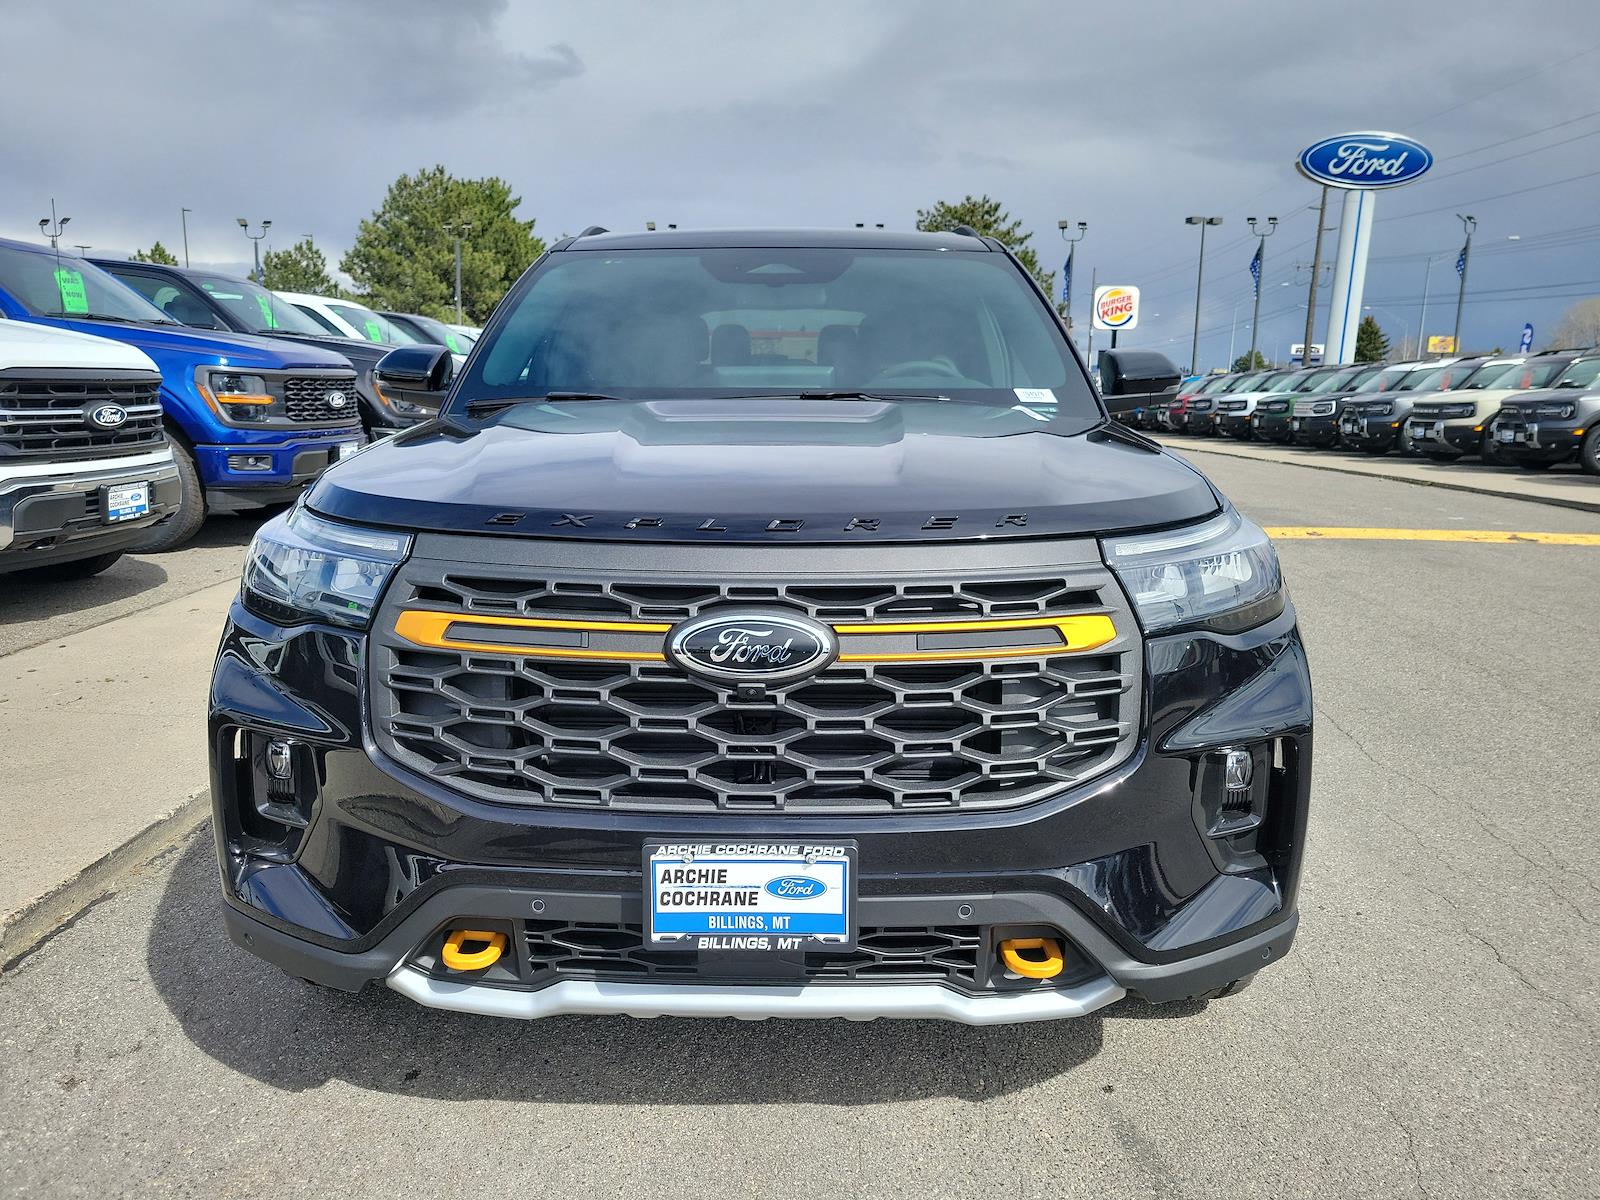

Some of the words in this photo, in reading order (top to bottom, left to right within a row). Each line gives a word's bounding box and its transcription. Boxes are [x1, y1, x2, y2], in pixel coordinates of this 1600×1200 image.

[1328, 142, 1409, 176] Ford
[1100, 295, 1132, 309] BURGER
[1101, 302, 1133, 320] KING
[100, 408, 122, 423] Ford
[485, 512, 1028, 532] EXPLORER
[709, 628, 793, 664] Ford
[656, 845, 712, 856] ARCHIE
[714, 844, 801, 856] COCHRANE
[802, 846, 845, 857] FORD
[660, 869, 728, 884] ARCHIE
[777, 878, 815, 896] Ford
[659, 891, 759, 906] COCHRANE
[708, 915, 768, 931] BILLINGS,
[772, 916, 791, 929] MT
[697, 937, 772, 951] BILLINGS,
[777, 937, 803, 950] MT
